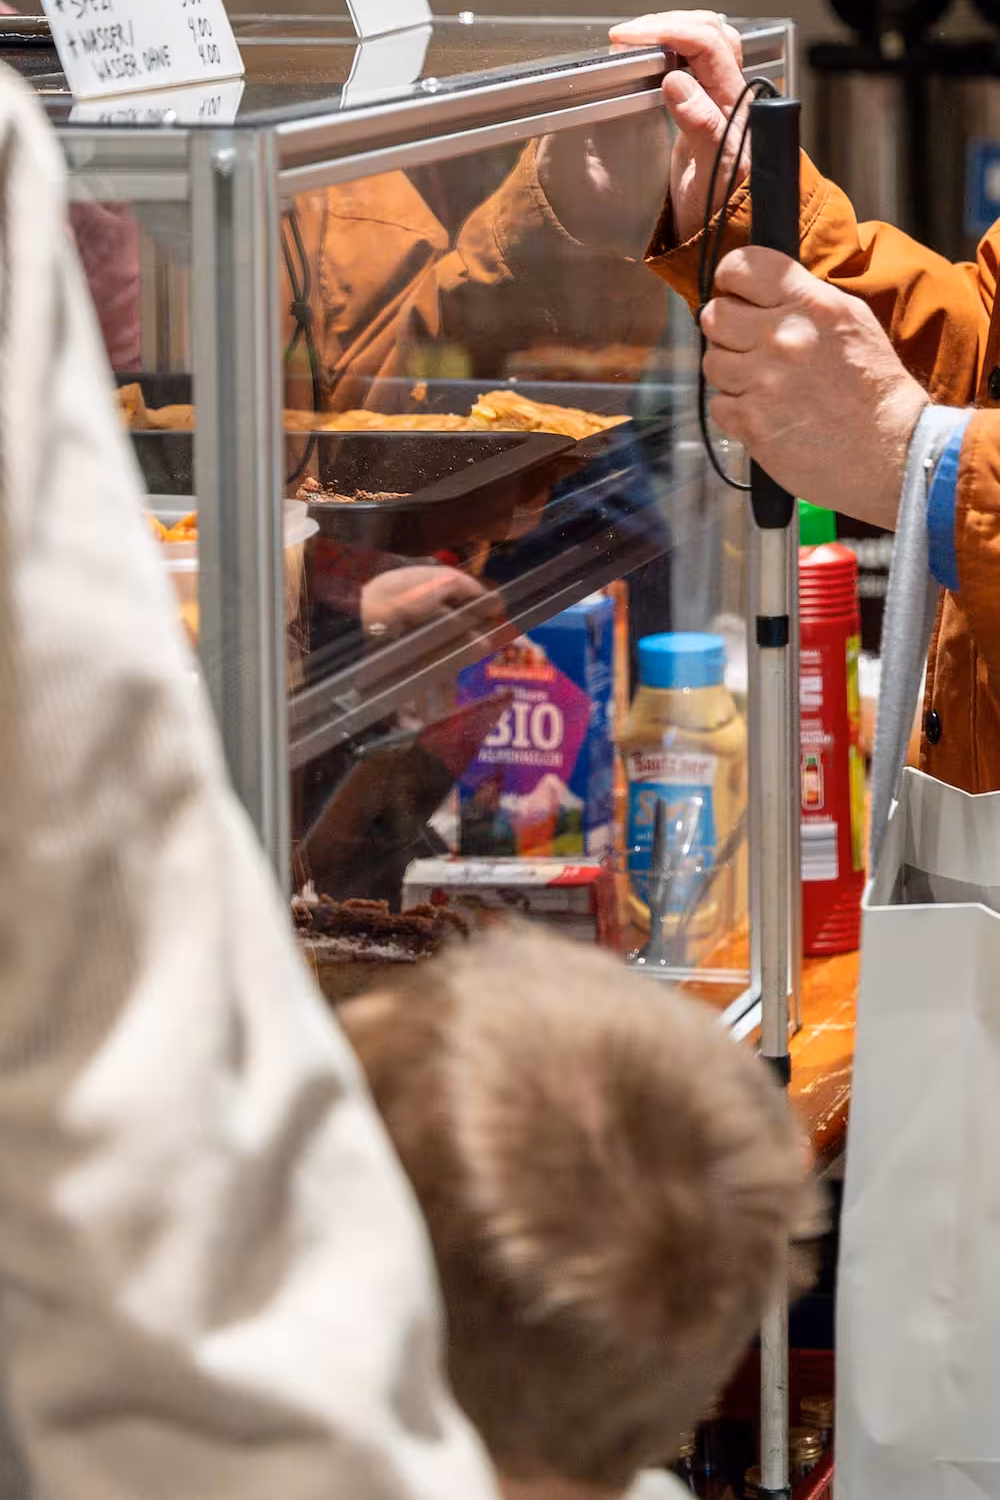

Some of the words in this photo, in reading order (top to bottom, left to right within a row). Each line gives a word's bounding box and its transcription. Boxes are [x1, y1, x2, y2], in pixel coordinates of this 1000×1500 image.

[187, 16, 212, 43] 4.00
[92, 53, 142, 83] WASSER
[198, 44, 221, 67] 4.00
